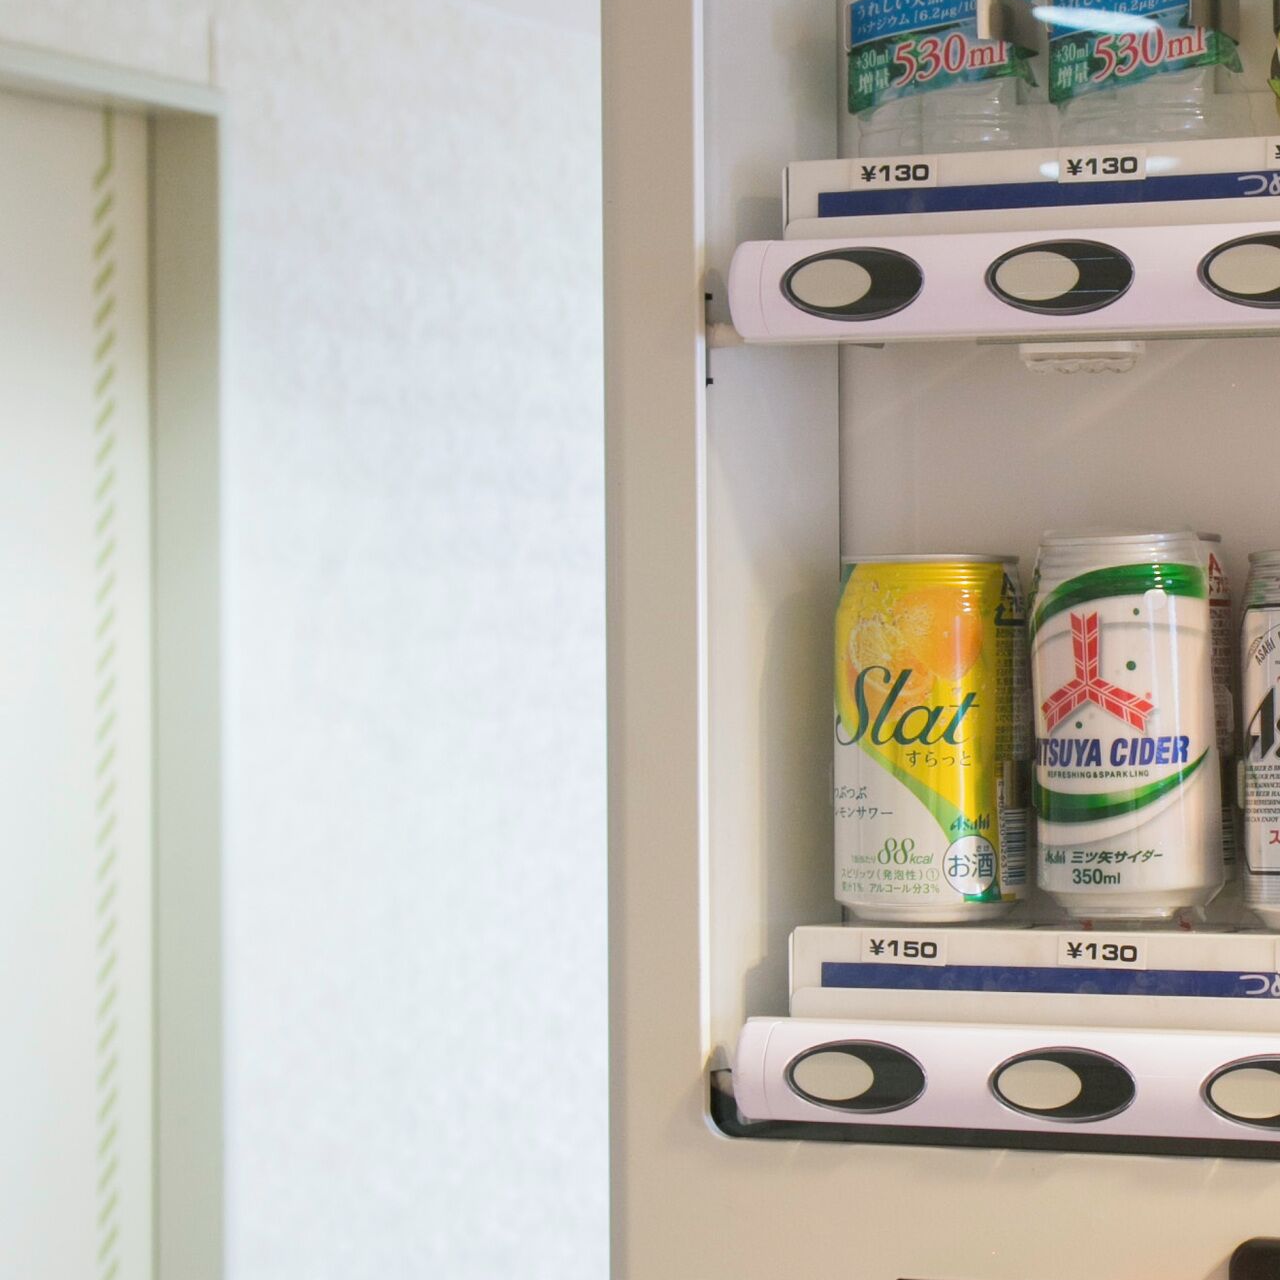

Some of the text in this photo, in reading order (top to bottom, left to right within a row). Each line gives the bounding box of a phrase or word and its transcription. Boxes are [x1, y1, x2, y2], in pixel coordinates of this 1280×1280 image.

[895, 33, 1007, 88] 530ml
[1093, 25, 1206, 82] 530ml
[861, 164, 931, 183] ¥130
[1066, 156, 1139, 177] ¥130
[1255, 637, 1276, 666] ASAHI
[835, 665, 980, 747] Slat
[905, 749, 973, 768] すらっと
[1110, 735, 1190, 767] CIDER
[949, 813, 990, 831] Asahi
[947, 853, 993, 878] お酒
[1071, 849, 1164, 865] 三ツ矢サイダー
[1072, 867, 1121, 885] 350ml
[869, 939, 938, 959] ¥150
[1067, 942, 1138, 962] ¥130
